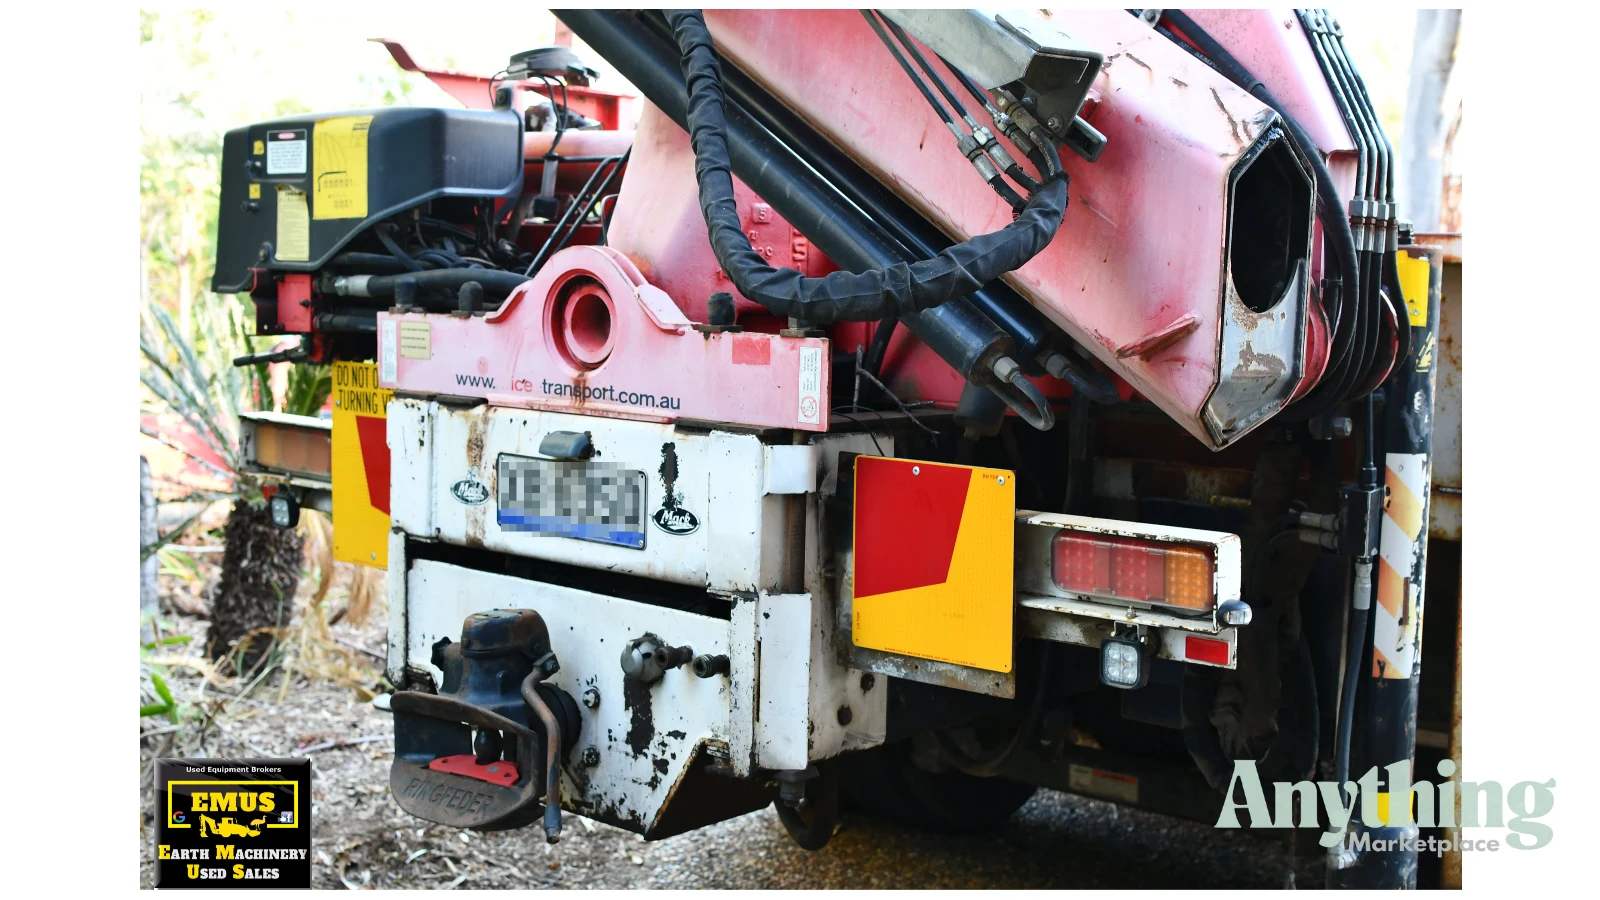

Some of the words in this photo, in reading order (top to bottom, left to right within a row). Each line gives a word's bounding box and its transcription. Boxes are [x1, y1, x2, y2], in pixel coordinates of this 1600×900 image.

[337, 364, 349, 387] DO
[352, 365, 369, 389] NOT
[373, 367, 379, 389] O
[338, 389, 378, 414] TURNING
[456, 373, 496, 389] www.
[511, 377, 533, 393] ice
[542, 378, 681, 410] transport.com.au
[457, 481, 485, 500] Mack
[660, 509, 695, 530] Mack
[402, 778, 494, 816] RINGFEDER
